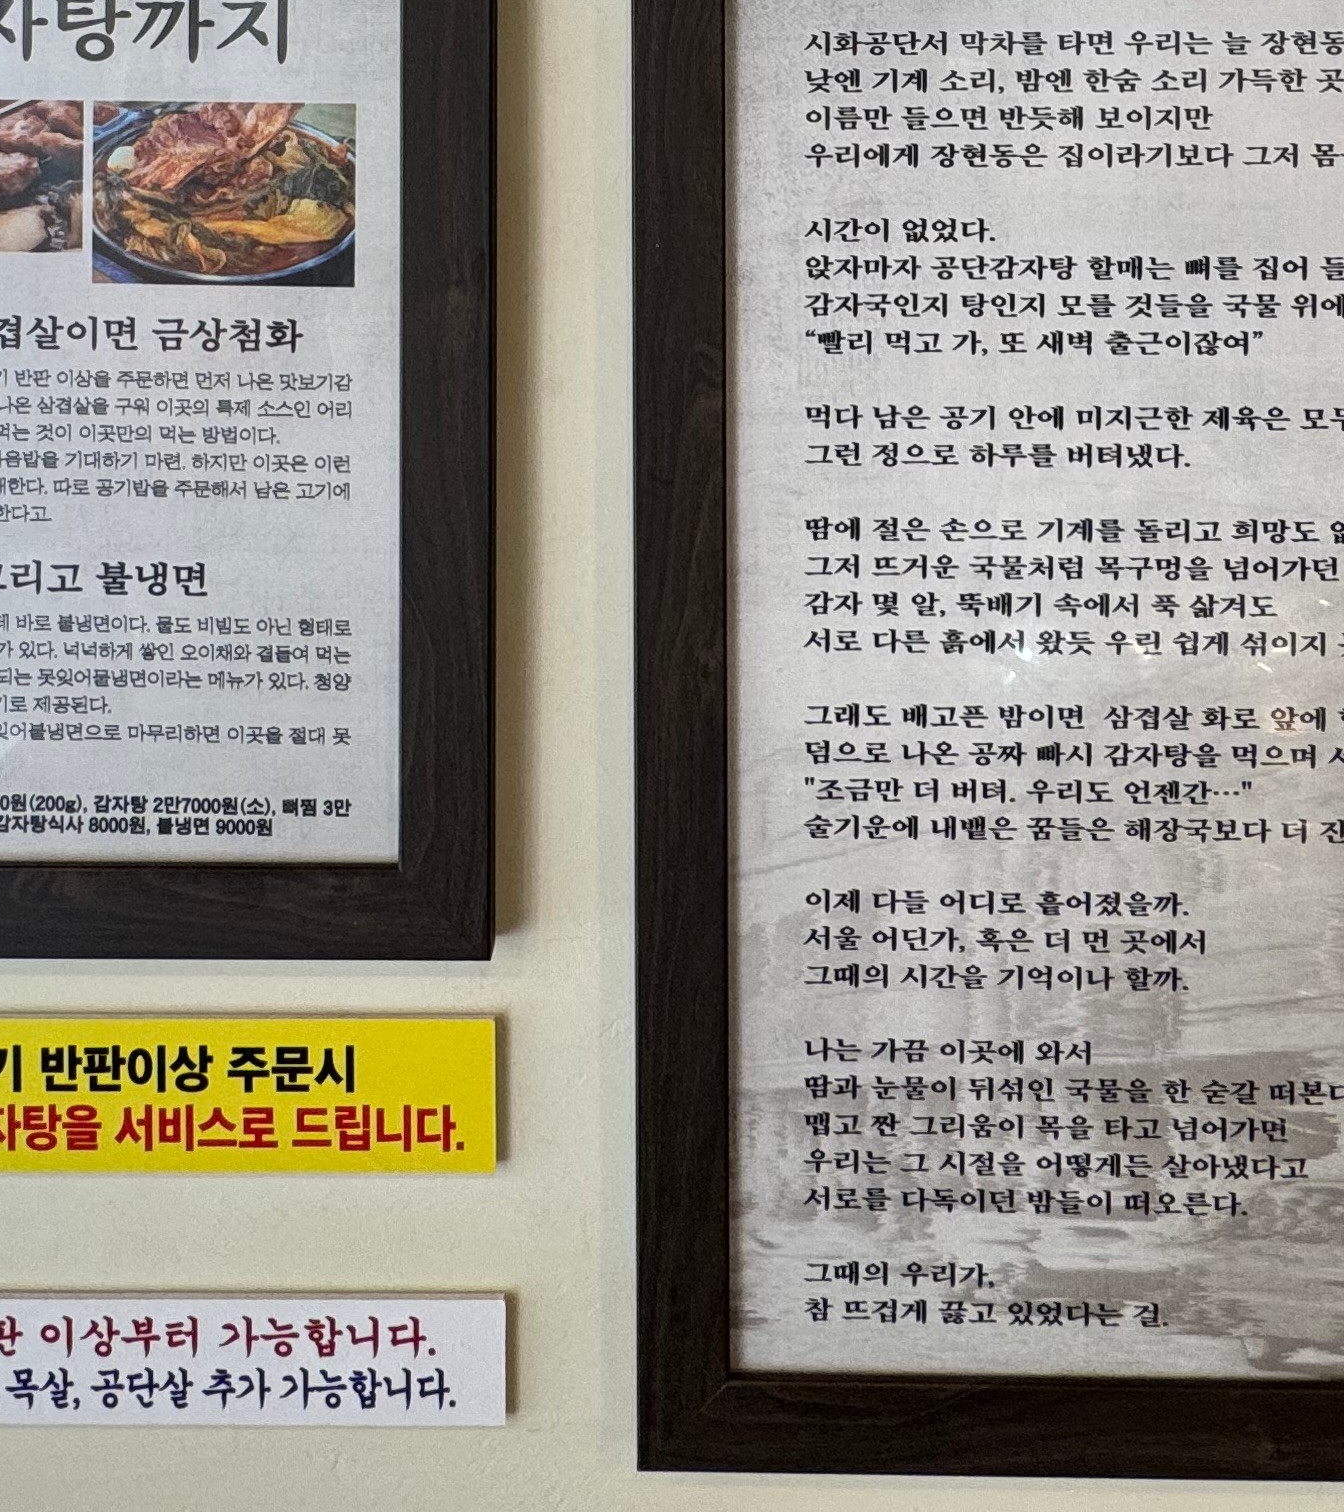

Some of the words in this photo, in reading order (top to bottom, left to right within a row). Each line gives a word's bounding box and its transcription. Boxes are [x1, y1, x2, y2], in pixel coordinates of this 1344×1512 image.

[804, 29, 948, 57] 시화공단서
[959, 29, 1048, 57] 막차를
[1056, 29, 1115, 57] 타면
[1123, 28, 1214, 56] 우리는
[1221, 30, 1252, 56] 늘
[804, 67, 863, 94] 낮엔
[871, 67, 928, 94] 기계
[939, 67, 1005, 94] 소리,
[1015, 67, 1074, 93] 밤엔
[1082, 67, 1142, 93] 한숨
[1150, 67, 1207, 94] 소리
[1218, 66, 1308, 94] 가득한
[804, 142, 919, 169] 우리에게
[930, 142, 1049, 169] 장현동은
[1057, 141, 1235, 169] 집이라기보다
[1242, 141, 1299, 169] 그저
[151, 315, 304, 354] 금상첨화
[13, 367, 52, 388] 반판
[56, 368, 112, 389] 이상을
[116, 369, 190, 390] 주문하면
[194, 370, 231, 391] 먼저
[236, 370, 275, 392] 나온
[278, 371, 354, 393] 맛보기감
[64, 449, 138, 470] 기대하기
[144, 451, 186, 472] 마련.
[191, 451, 248, 472] 하지만
[252, 452, 310, 474] 이곳은
[314, 454, 351, 474] 이런
[804, 440, 862, 467] 그런
[872, 440, 960, 468] 정으로
[968, 442, 1058, 468] 하루를
[1066, 442, 1191, 469] 버텨냈다.
[95, 560, 208, 597] 불냉면
[32, 694, 112, 715] 제공된다.
[93, 793, 149, 815] 감자탕
[152, 794, 277, 817] 2만7000원(소),
[322, 797, 353, 818] 3만
[88, 815, 151, 836] 8000원,
[215, 816, 273, 837] 9000원
[805, 887, 861, 915] 이제
[872, 888, 930, 915] 다들
[939, 889, 1027, 916] 어디로
[803, 962, 889, 989] 그때의
[900, 962, 988, 990] 시간을
[996, 964, 1116, 992] 기억이나
[1123, 965, 1189, 993] 할까.
[40, 1044, 214, 1093] 반판이상
[227, 1044, 355, 1093] 주문시
[114, 1103, 279, 1152] 서비스로
[291, 1103, 465, 1153] 드립니다.
[803, 1259, 889, 1287] 그때의
[899, 1261, 995, 1289] 우리가,
[804, 1296, 834, 1323] 참
[842, 1297, 928, 1325] 뜨겁게
[938, 1295, 998, 1326] 끓고
[1007, 1299, 1124, 1328] 있었다는
[1133, 1301, 1169, 1328] 걸.
[40, 1314, 199, 1359] 이상부터
[218, 1314, 437, 1359] 가능합니다.
[4, 1366, 81, 1411] 목살,
[90, 1365, 194, 1410] 공단살
[201, 1366, 272, 1410] 추가
[279, 1365, 457, 1411] 가능합니다.
